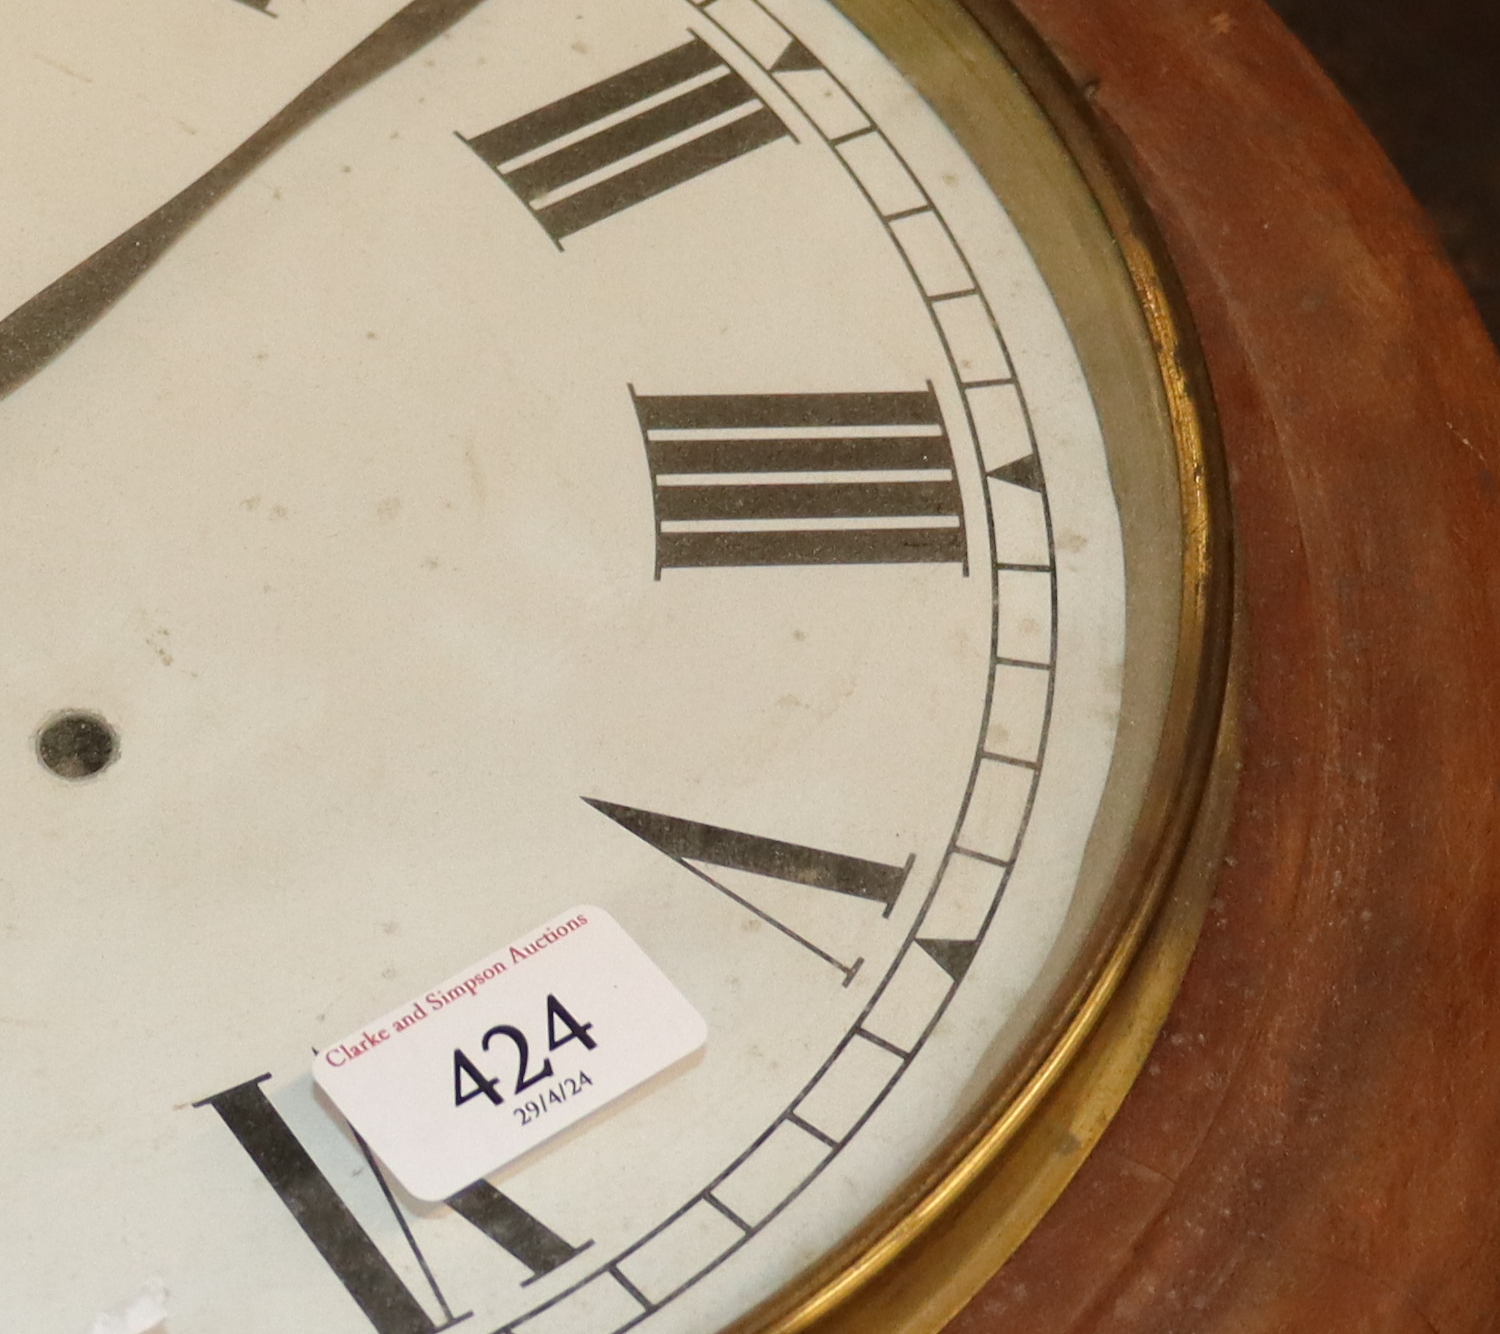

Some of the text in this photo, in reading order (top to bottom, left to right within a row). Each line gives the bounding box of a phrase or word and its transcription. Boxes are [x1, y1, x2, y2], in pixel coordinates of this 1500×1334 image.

[453, 29, 801, 253] III
[627, 379, 970, 582] IIII
[580, 796, 916, 987] V
[324, 913, 589, 1070] Clarke and Simpson Auctions
[453, 993, 598, 1108] 424
[513, 1069, 594, 1127] 29/4/24
